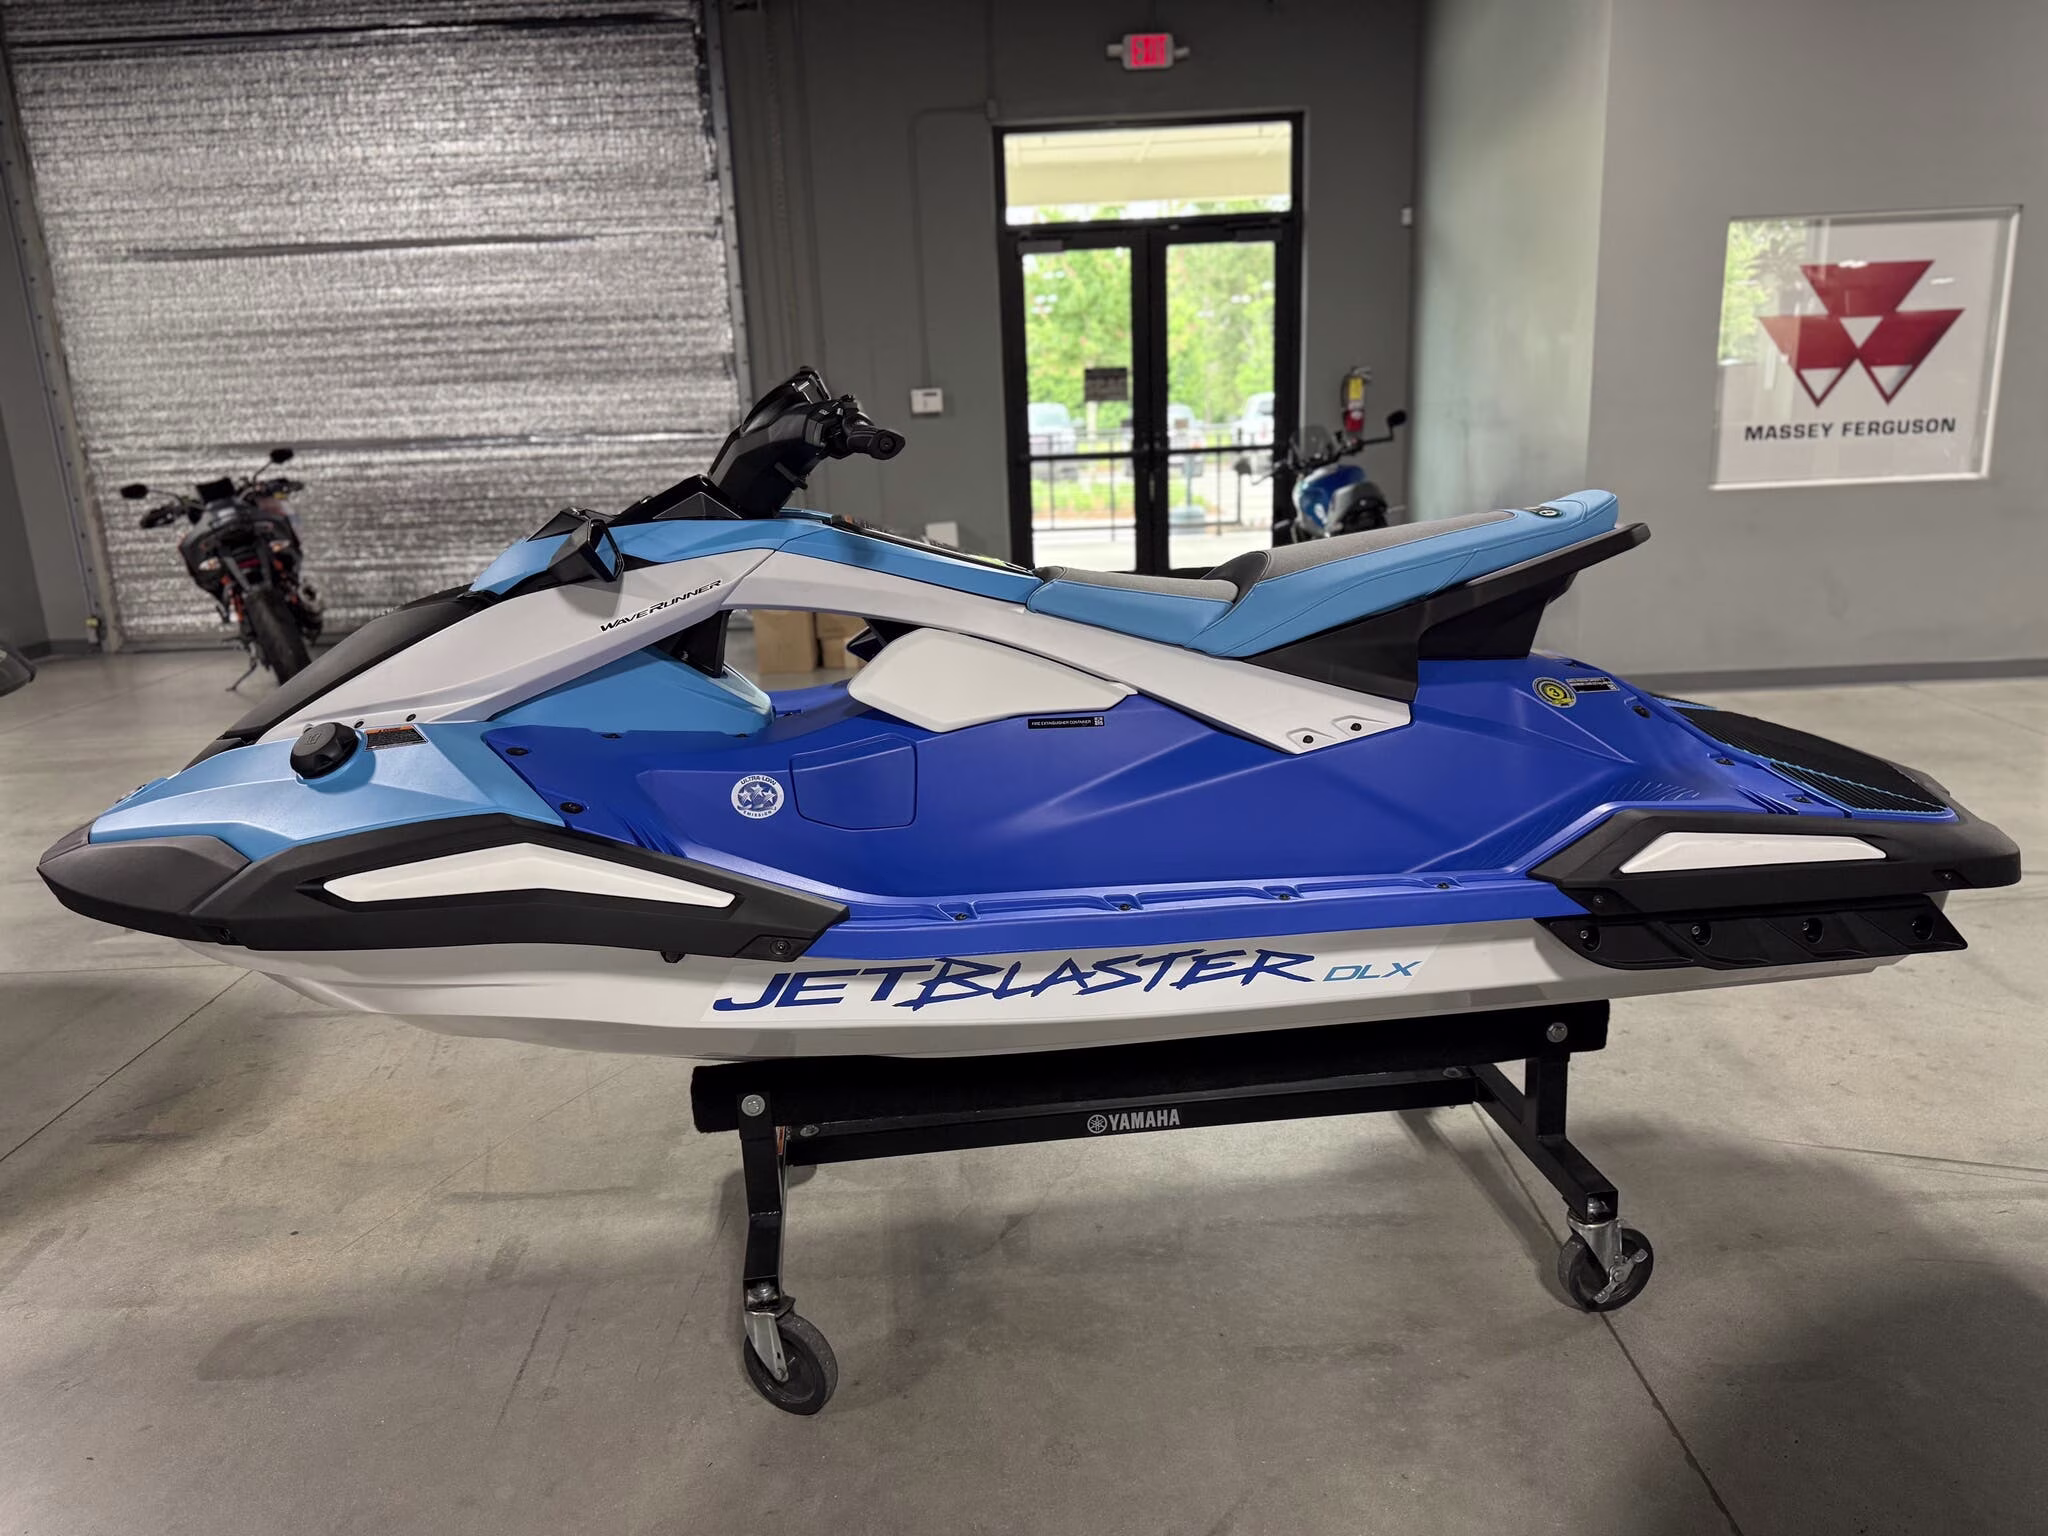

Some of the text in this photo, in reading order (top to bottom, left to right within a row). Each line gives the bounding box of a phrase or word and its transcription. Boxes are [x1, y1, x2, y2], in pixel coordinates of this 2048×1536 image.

[1133, 37, 1167, 65] EXIT
[1744, 417, 1957, 442] MASSEY FERGUSON
[740, 775, 777, 786] ULTRA LOW
[1322, 960, 1422, 982] DLX
[1108, 1108, 1180, 1131] YAMAHA
